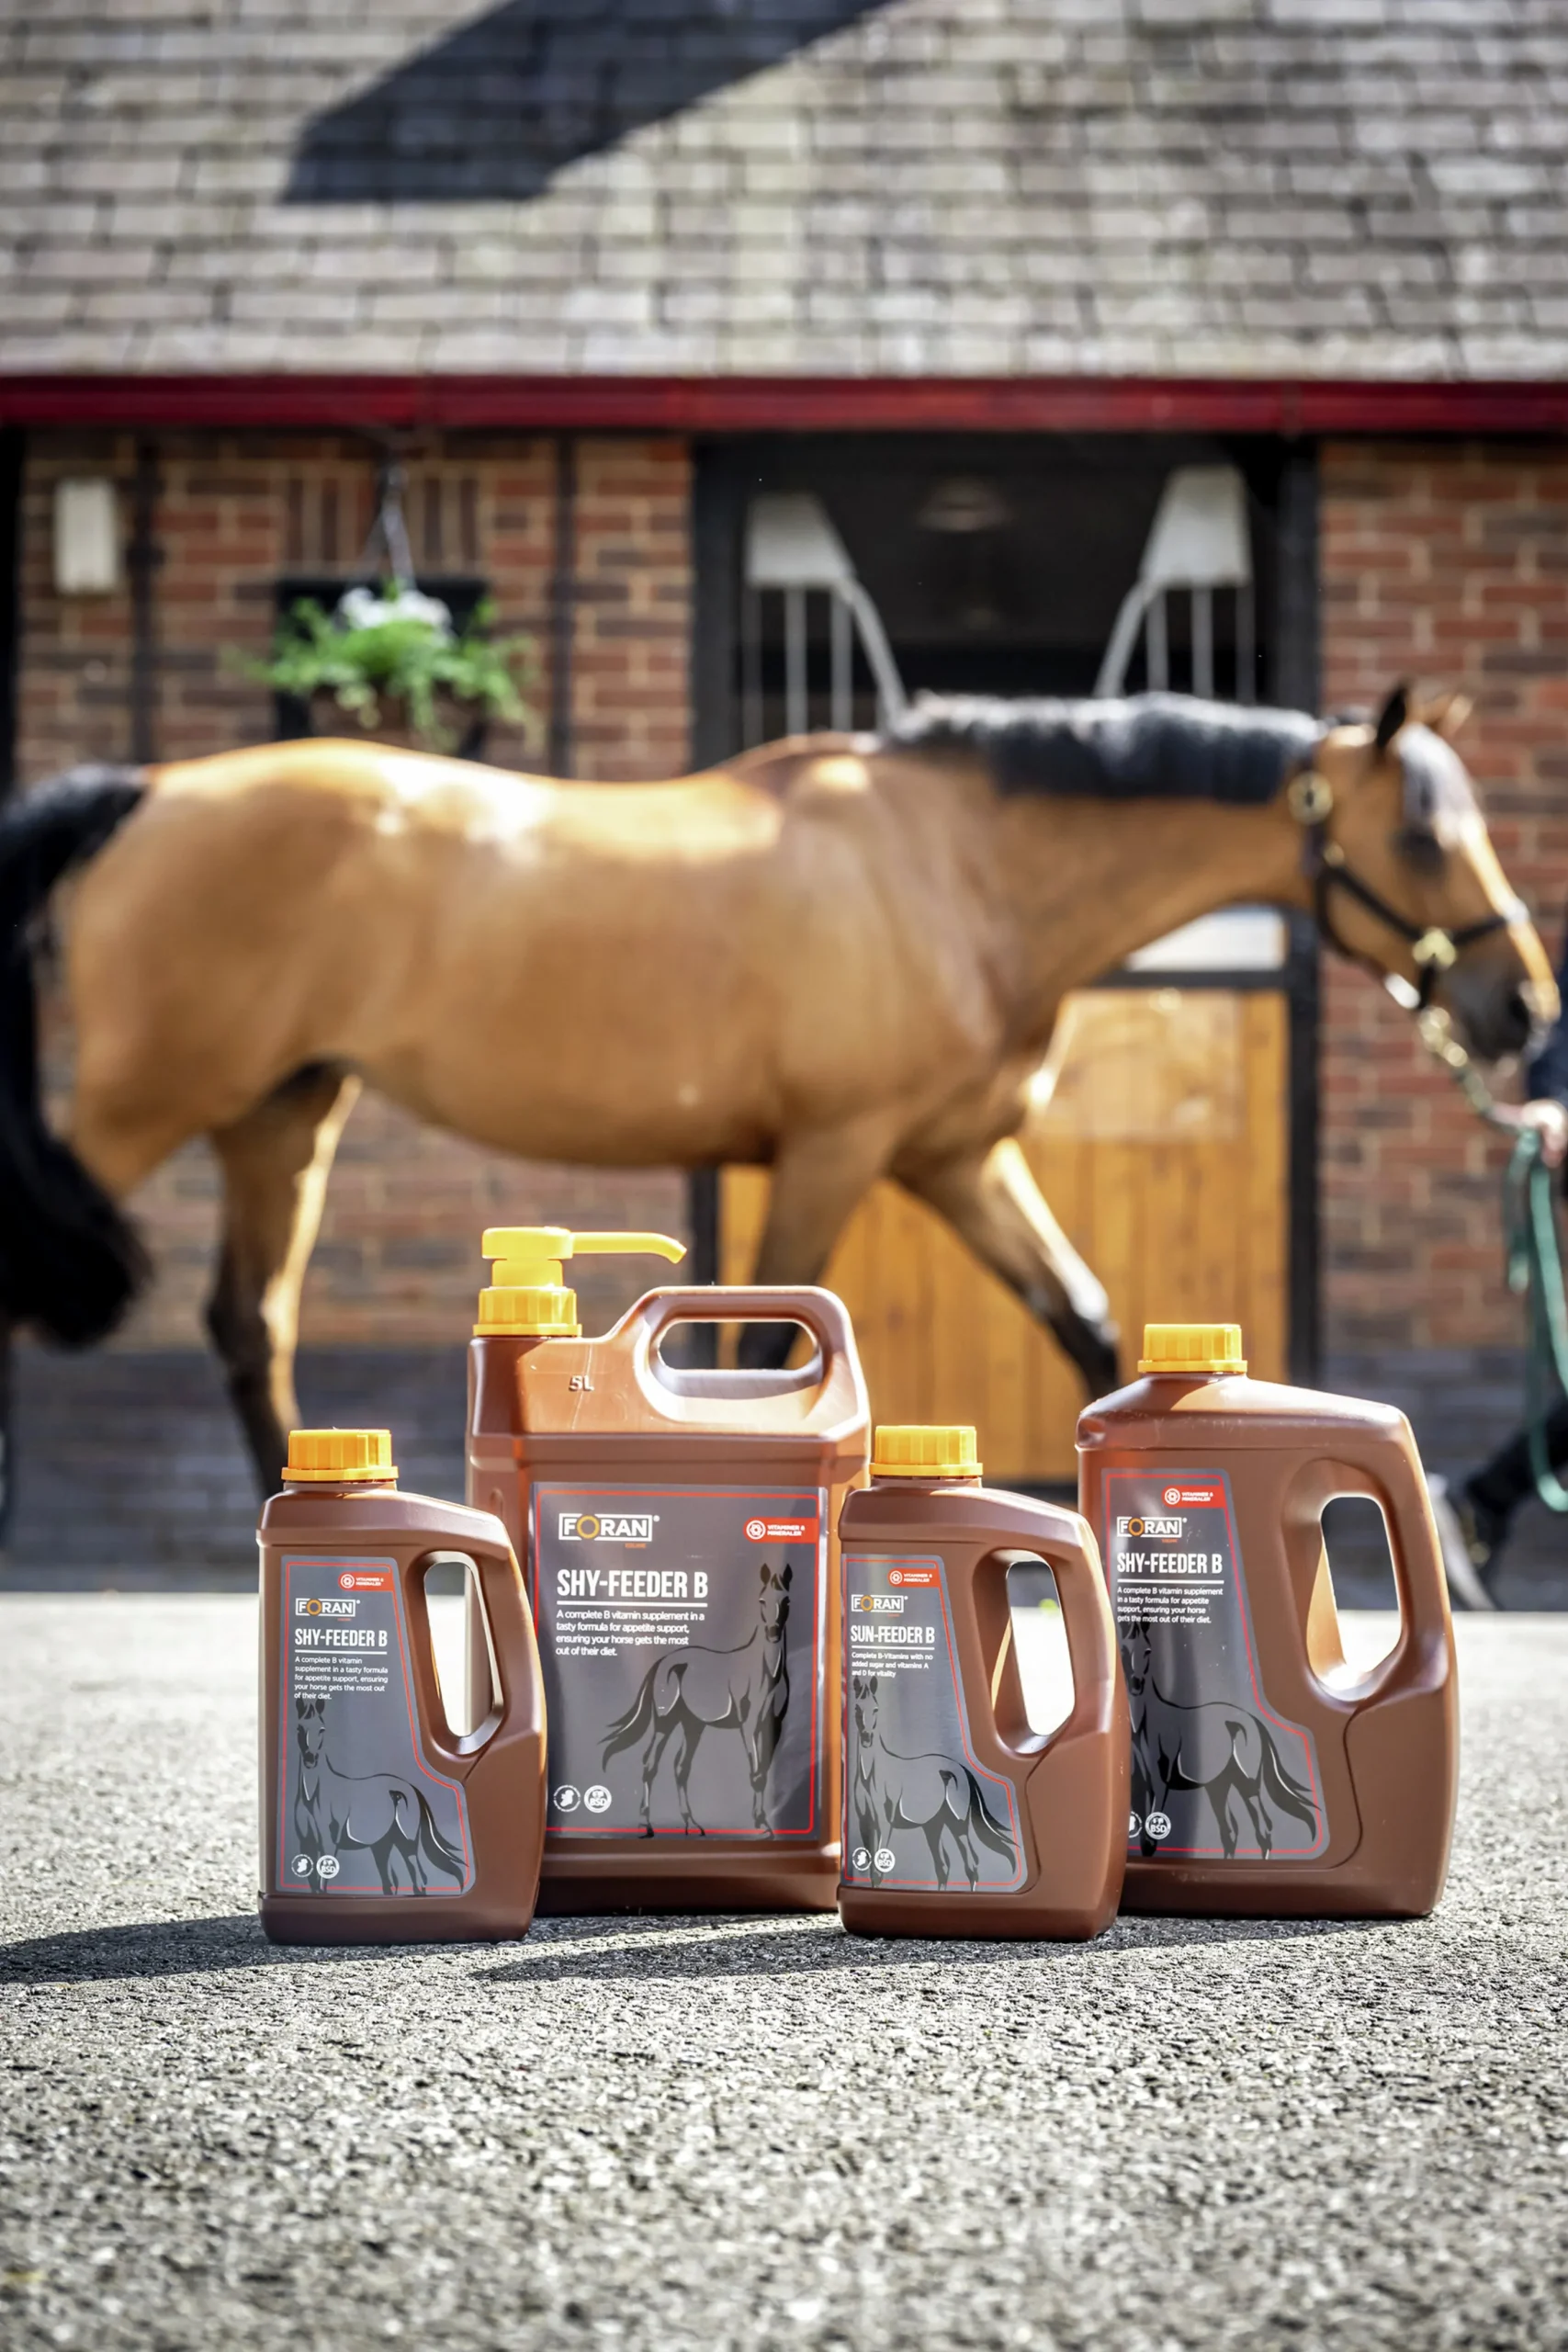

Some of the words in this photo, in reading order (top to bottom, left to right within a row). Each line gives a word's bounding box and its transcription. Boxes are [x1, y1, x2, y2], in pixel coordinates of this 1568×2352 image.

[569, 1374, 594, 1392] 5L
[564, 1515, 648, 1540] FORAN
[1120, 1517, 1179, 1536] FORAN
[1117, 1553, 1208, 1574] SHY-FEEDER
[1212, 1554, 1223, 1574] B
[557, 1568, 688, 1597] SHY-FEEDER
[694, 1572, 708, 1599] B
[1184, 1588, 1224, 1596] supplement
[854, 1595, 901, 1611] FORAN
[1129, 1597, 1144, 1605] tasty
[299, 1600, 353, 1615] FORAN
[1143, 1606, 1169, 1614] ensuring
[556, 1610, 564, 1619] A
[565, 1610, 603, 1620] complete
[604, 1611, 610, 1619] B
[611, 1611, 641, 1620] vitamin
[642, 1611, 689, 1622] supplement
[690, 1611, 698, 1621] in
[1179, 1615, 1196, 1623] their
[556, 1623, 576, 1633] tasty
[577, 1623, 608, 1631] formula
[609, 1623, 621, 1632] for
[622, 1623, 655, 1634] appetite
[657, 1624, 690, 1634] support,
[295, 1628, 375, 1646] SHY-FEEDER
[378, 1630, 388, 1647] B
[556, 1635, 591, 1645] ensuring
[592, 1636, 610, 1645] your
[611, 1635, 634, 1644] horse
[635, 1636, 652, 1645] gets
[653, 1636, 668, 1645] the
[668, 1637, 689, 1645] most
[851, 1625, 922, 1643] SUN-FEEDER
[926, 1627, 935, 1644] B
[556, 1647, 570, 1656] out
[570, 1646, 581, 1656] of
[581, 1646, 599, 1656] their
[600, 1647, 617, 1656] diet.
[878, 1652, 909, 1660] B-Vitamins
[333, 1675, 358, 1683] support,
[876, 1669, 897, 1679] vitality
[1150, 1824, 1167, 1833] BSD
